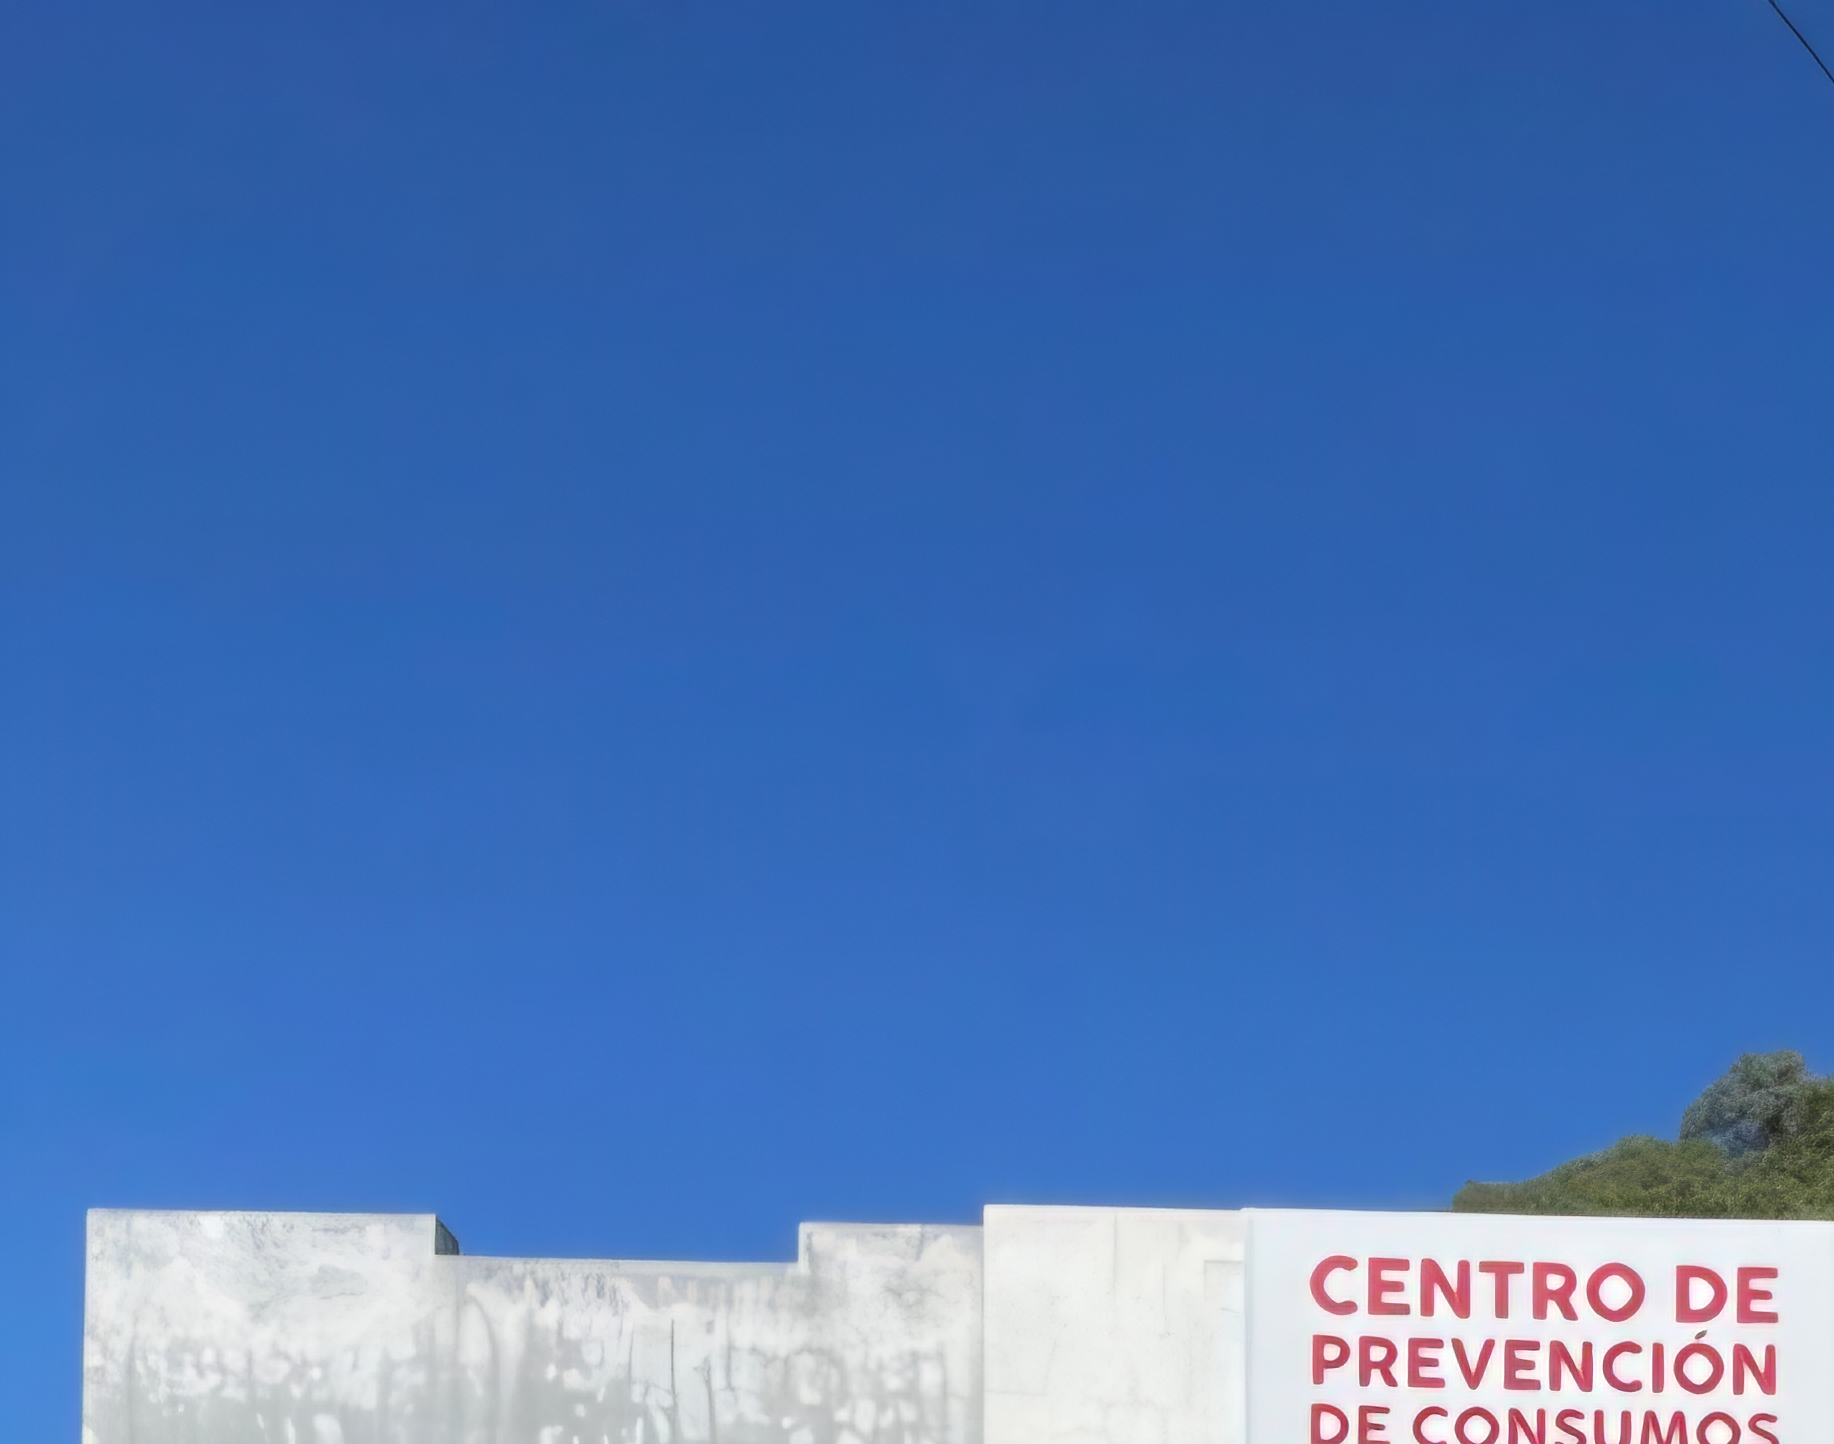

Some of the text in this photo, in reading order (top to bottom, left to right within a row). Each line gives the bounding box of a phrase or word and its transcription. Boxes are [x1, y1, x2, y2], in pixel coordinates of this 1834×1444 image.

[1308, 1254, 1780, 1325] CENTRO DE
[1310, 1329, 1778, 1396] PREVENCIÓN
